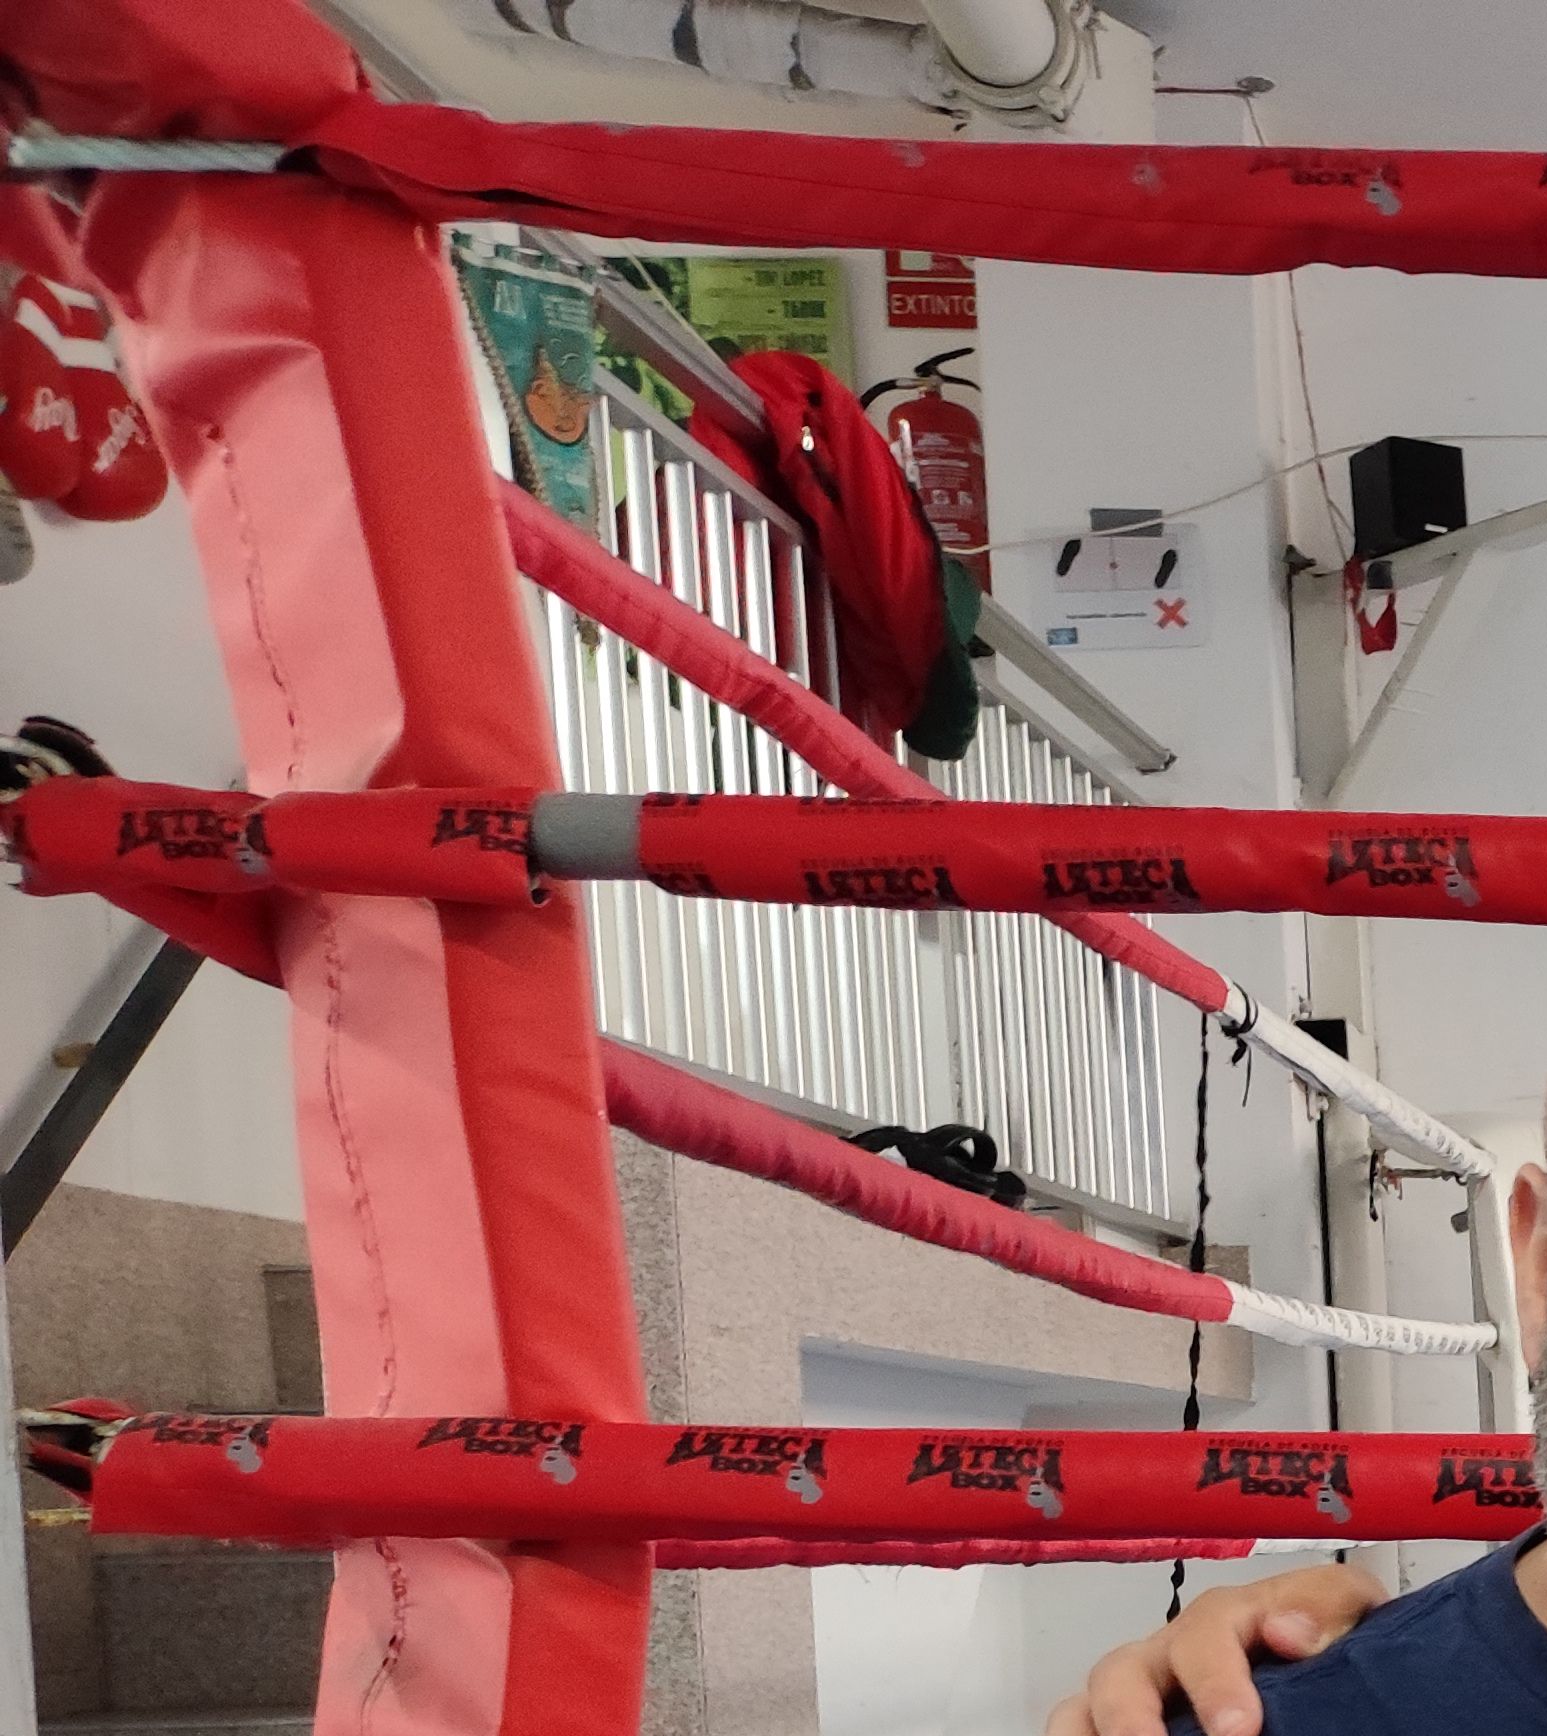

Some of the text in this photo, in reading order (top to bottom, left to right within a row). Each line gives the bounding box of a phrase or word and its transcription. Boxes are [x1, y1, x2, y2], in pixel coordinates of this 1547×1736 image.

[891, 294, 977, 315] EXTINTO
[1369, 867, 1436, 888] BOX
[666, 1430, 829, 1480] AZTECA
[710, 1455, 785, 1475] BOX
[907, 1443, 1063, 1493] AZTECA
[1196, 1448, 1354, 1499] AZTECA
[951, 1470, 1020, 1491] BOX
[1241, 1477, 1311, 1498] BOX
